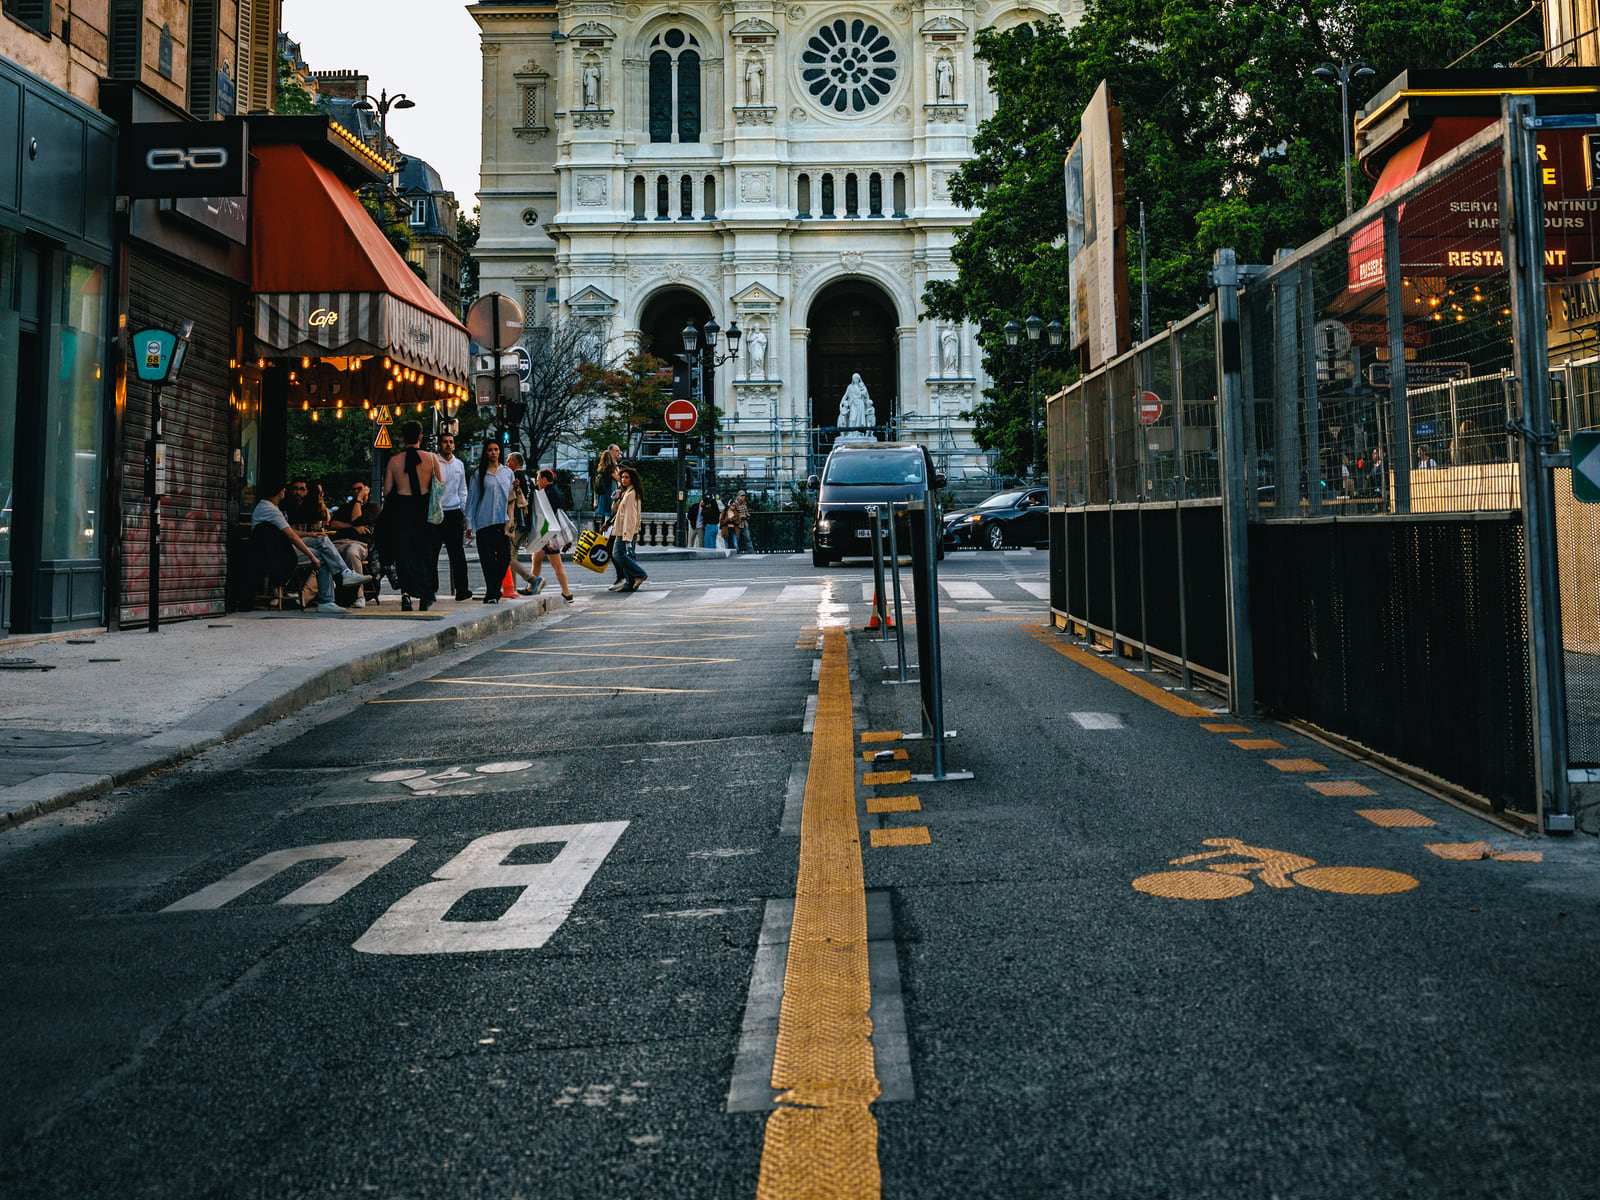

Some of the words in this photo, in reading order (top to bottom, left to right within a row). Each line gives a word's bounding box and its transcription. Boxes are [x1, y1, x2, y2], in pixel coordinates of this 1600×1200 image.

[1448, 250, 1566, 267] RESTANT
[308, 308, 338, 328] Café
[147, 355, 160, 363] 68
[590, 548, 609, 563] JD
